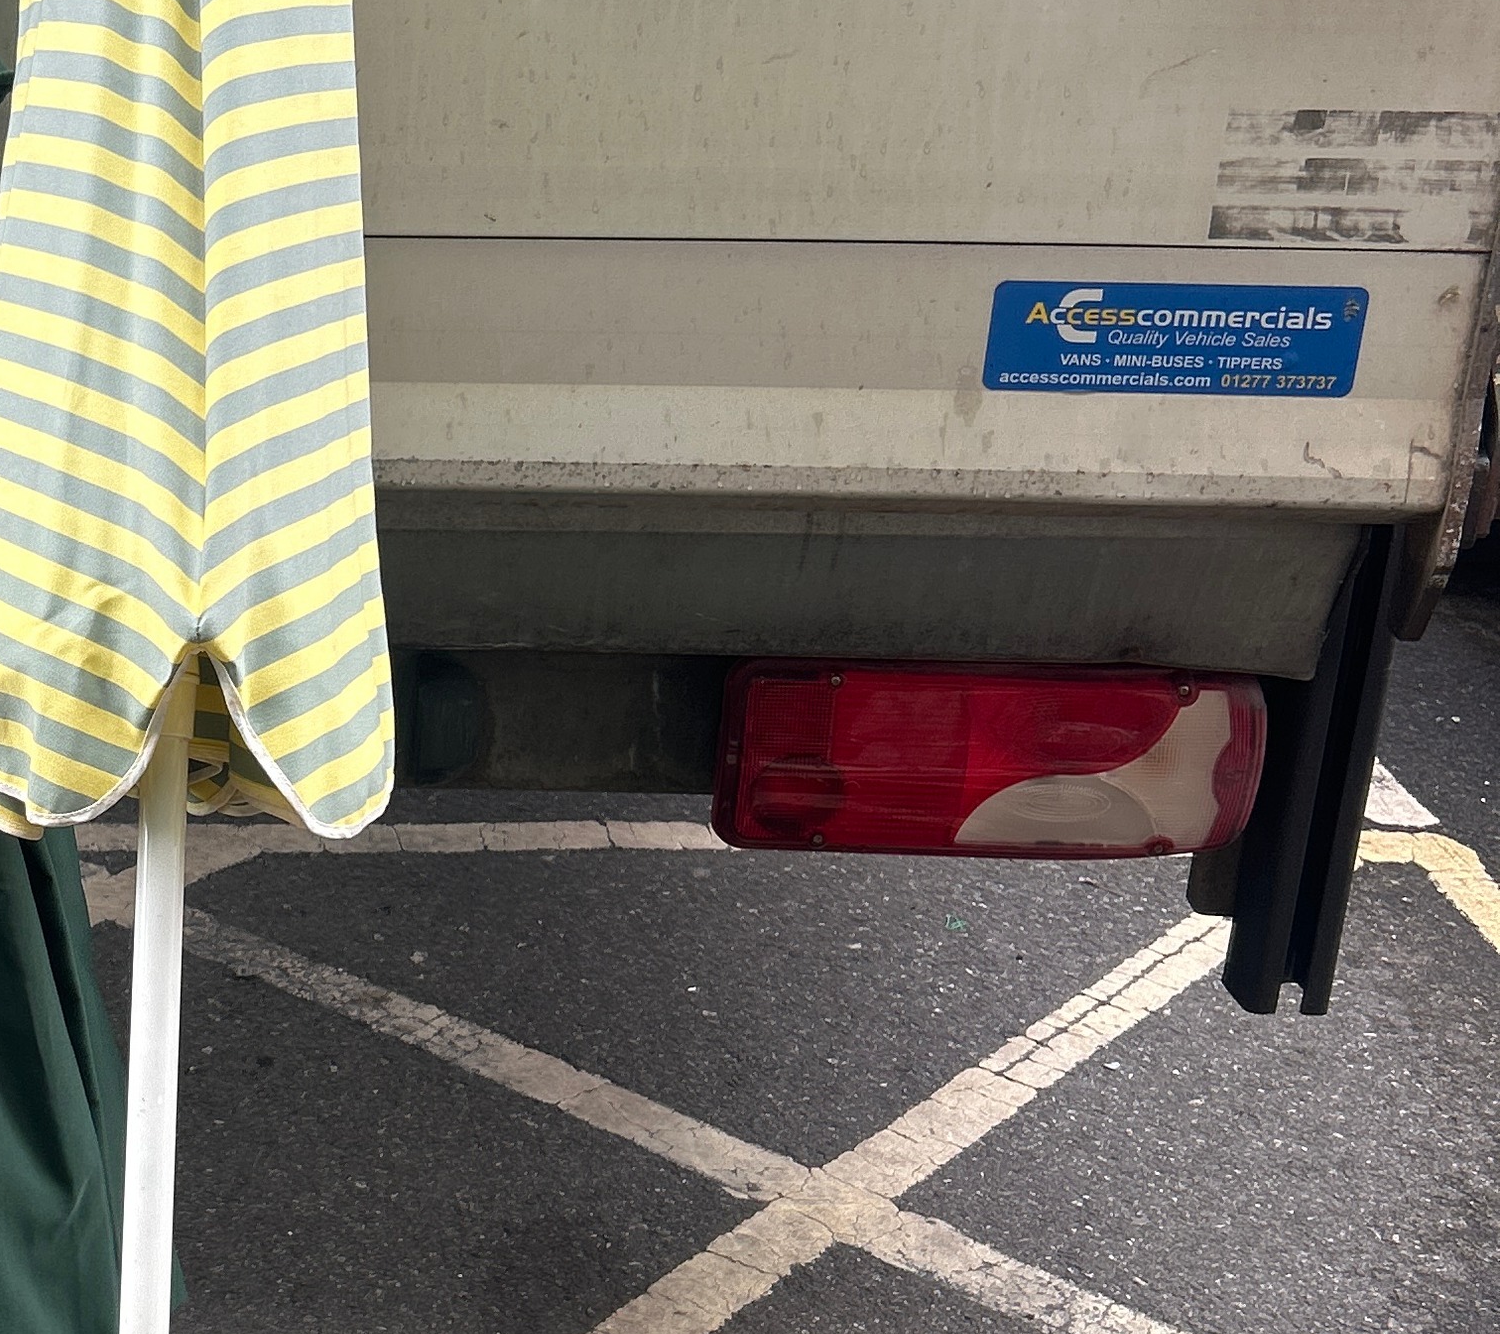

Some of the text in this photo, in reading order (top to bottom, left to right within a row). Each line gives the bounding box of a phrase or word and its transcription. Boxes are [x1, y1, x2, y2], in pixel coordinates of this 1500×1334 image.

[1107, 328, 1292, 349] Quality Vehicle Sales
[1059, 353, 1284, 370] VANS MINI-BUSES TIPPERS
[999, 369, 1338, 391] accesscommercials.com 01277 373737
